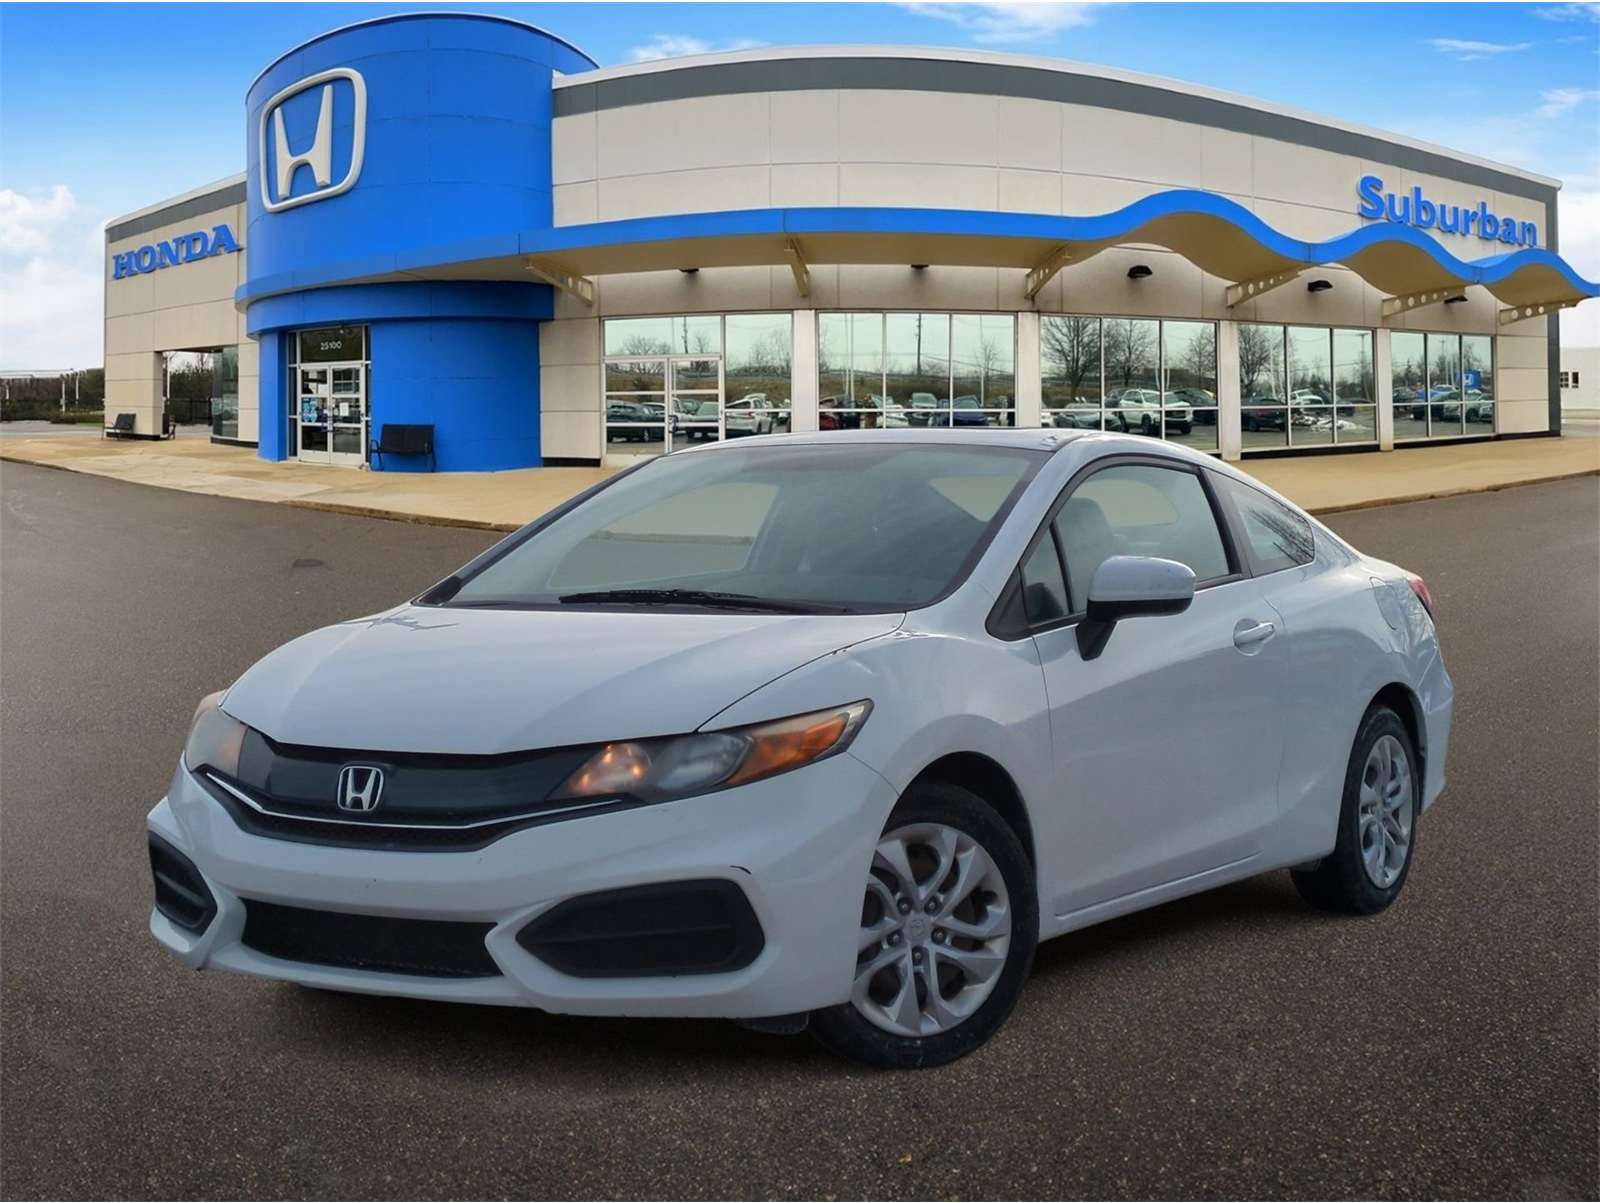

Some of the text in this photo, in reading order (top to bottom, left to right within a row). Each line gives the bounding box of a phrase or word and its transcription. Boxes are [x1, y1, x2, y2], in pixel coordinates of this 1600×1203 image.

[1358, 175, 1538, 247] Suburban
[112, 223, 241, 280] HONDA
[320, 341, 342, 350] 25100
